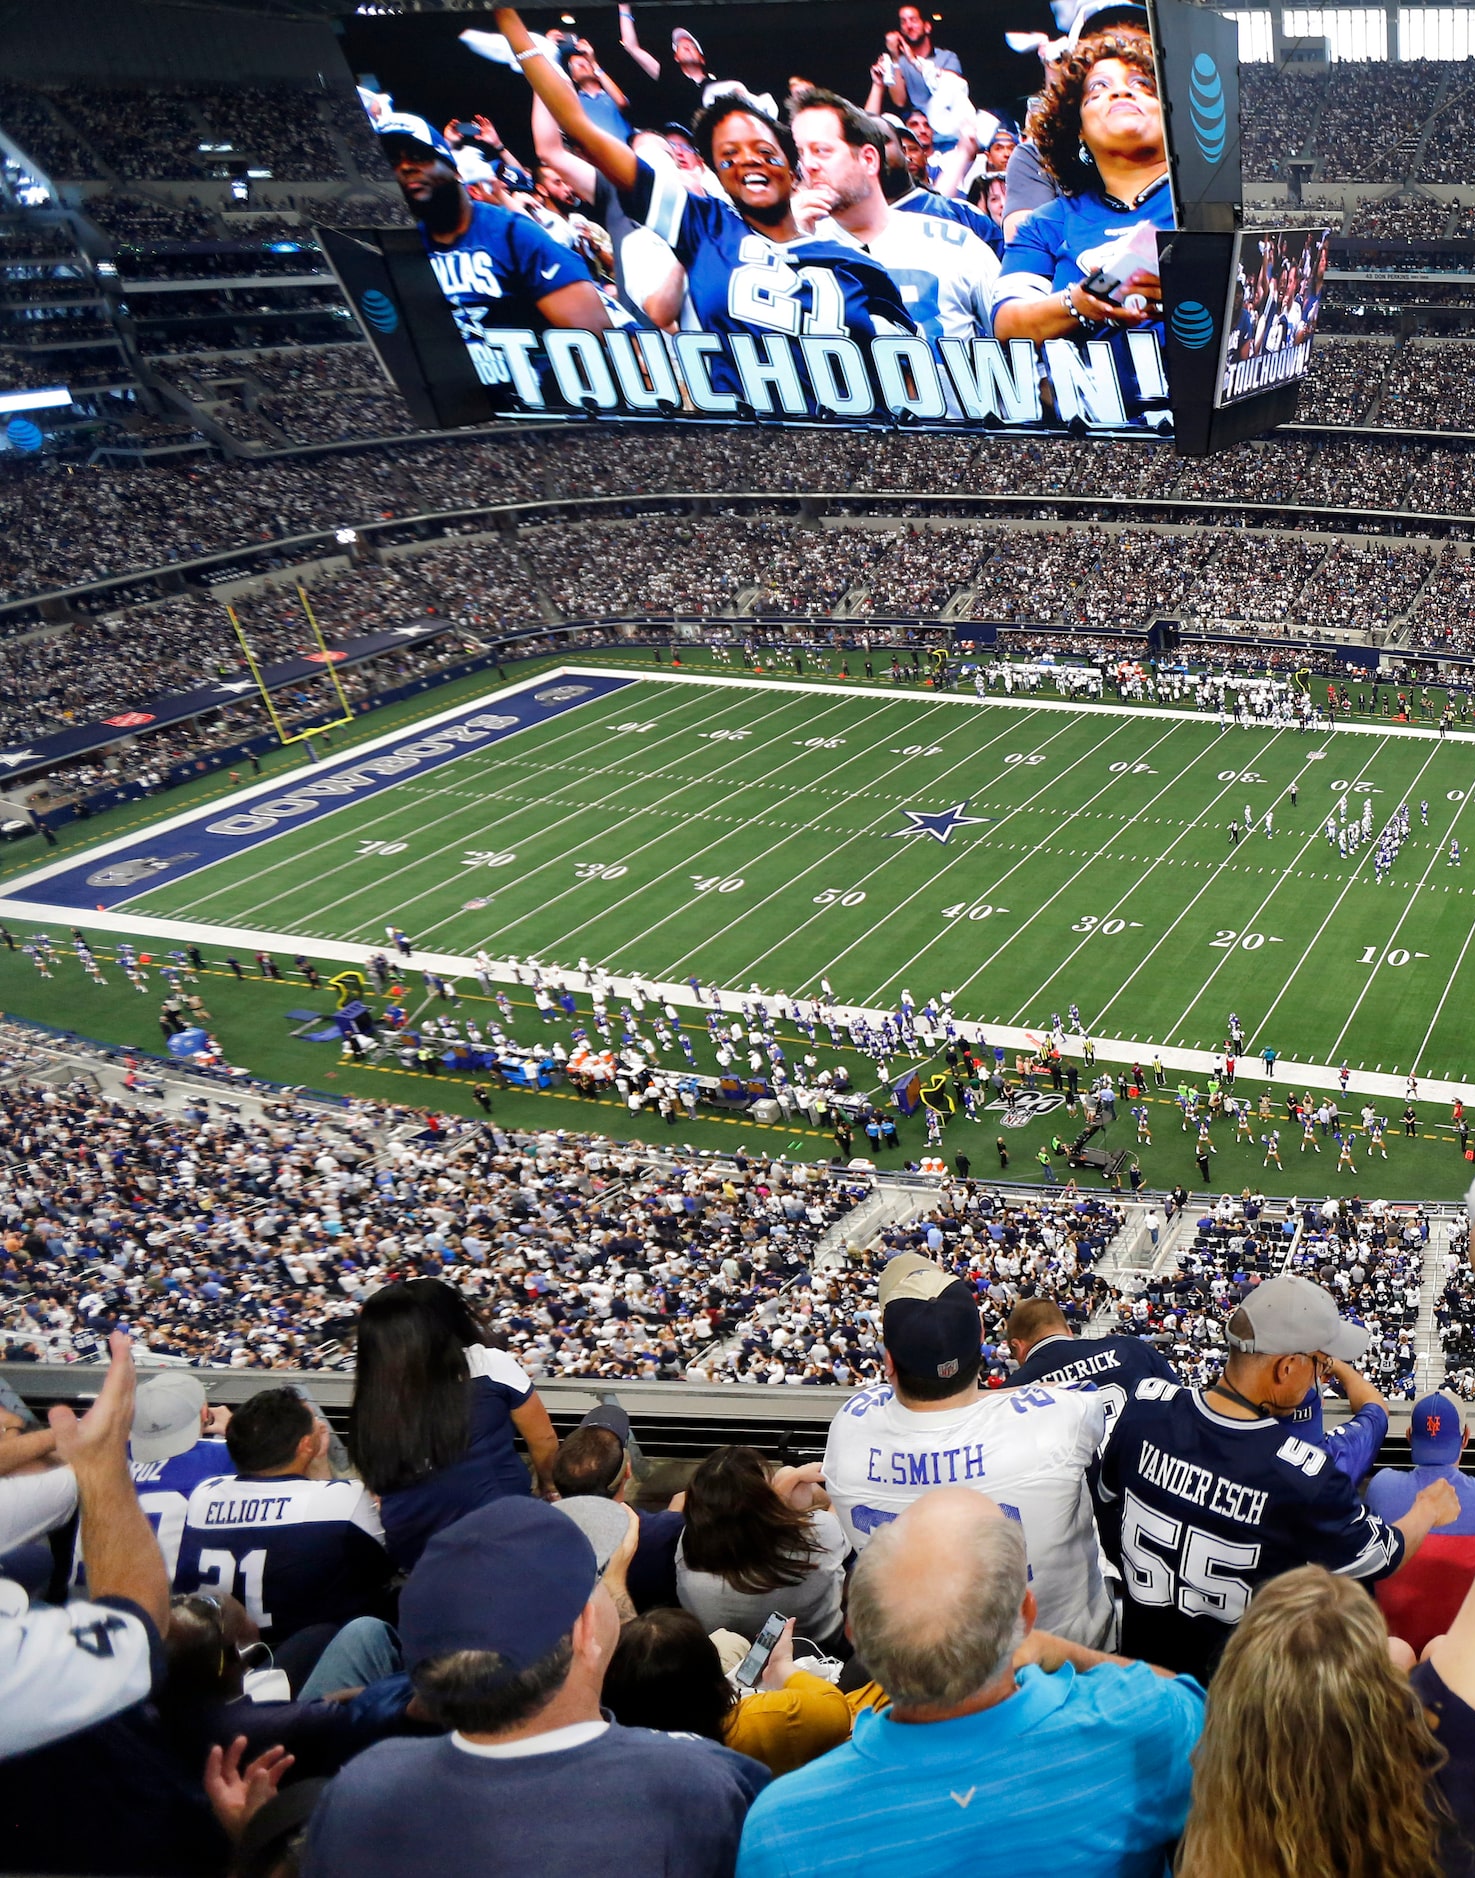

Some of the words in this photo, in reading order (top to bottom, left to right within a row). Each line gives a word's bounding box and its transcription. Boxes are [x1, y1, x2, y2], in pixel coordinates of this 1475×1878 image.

[487, 328, 1174, 428] TOUCHDOWN!
[1227, 340, 1310, 398] TOUCHDOWN!
[206, 713, 521, 836] COWBOYS
[355, 840, 409, 856] 10
[460, 851, 517, 868] 20
[574, 863, 629, 880] 30
[693, 876, 745, 893] 40
[812, 888, 867, 908] 50
[941, 901, 995, 922] 40
[1071, 915, 1128, 936] 30
[1209, 930, 1267, 951] 20
[1355, 945, 1413, 967] 10
[131, 1458, 170, 1482] RUZ
[867, 1444, 986, 1486] E.SMITH
[1137, 1440, 1213, 1507] VANDER
[1209, 1476, 1269, 1526] ESCH
[205, 1497, 292, 1526] ELLIOTT
[1121, 1487, 1262, 1624] 55
